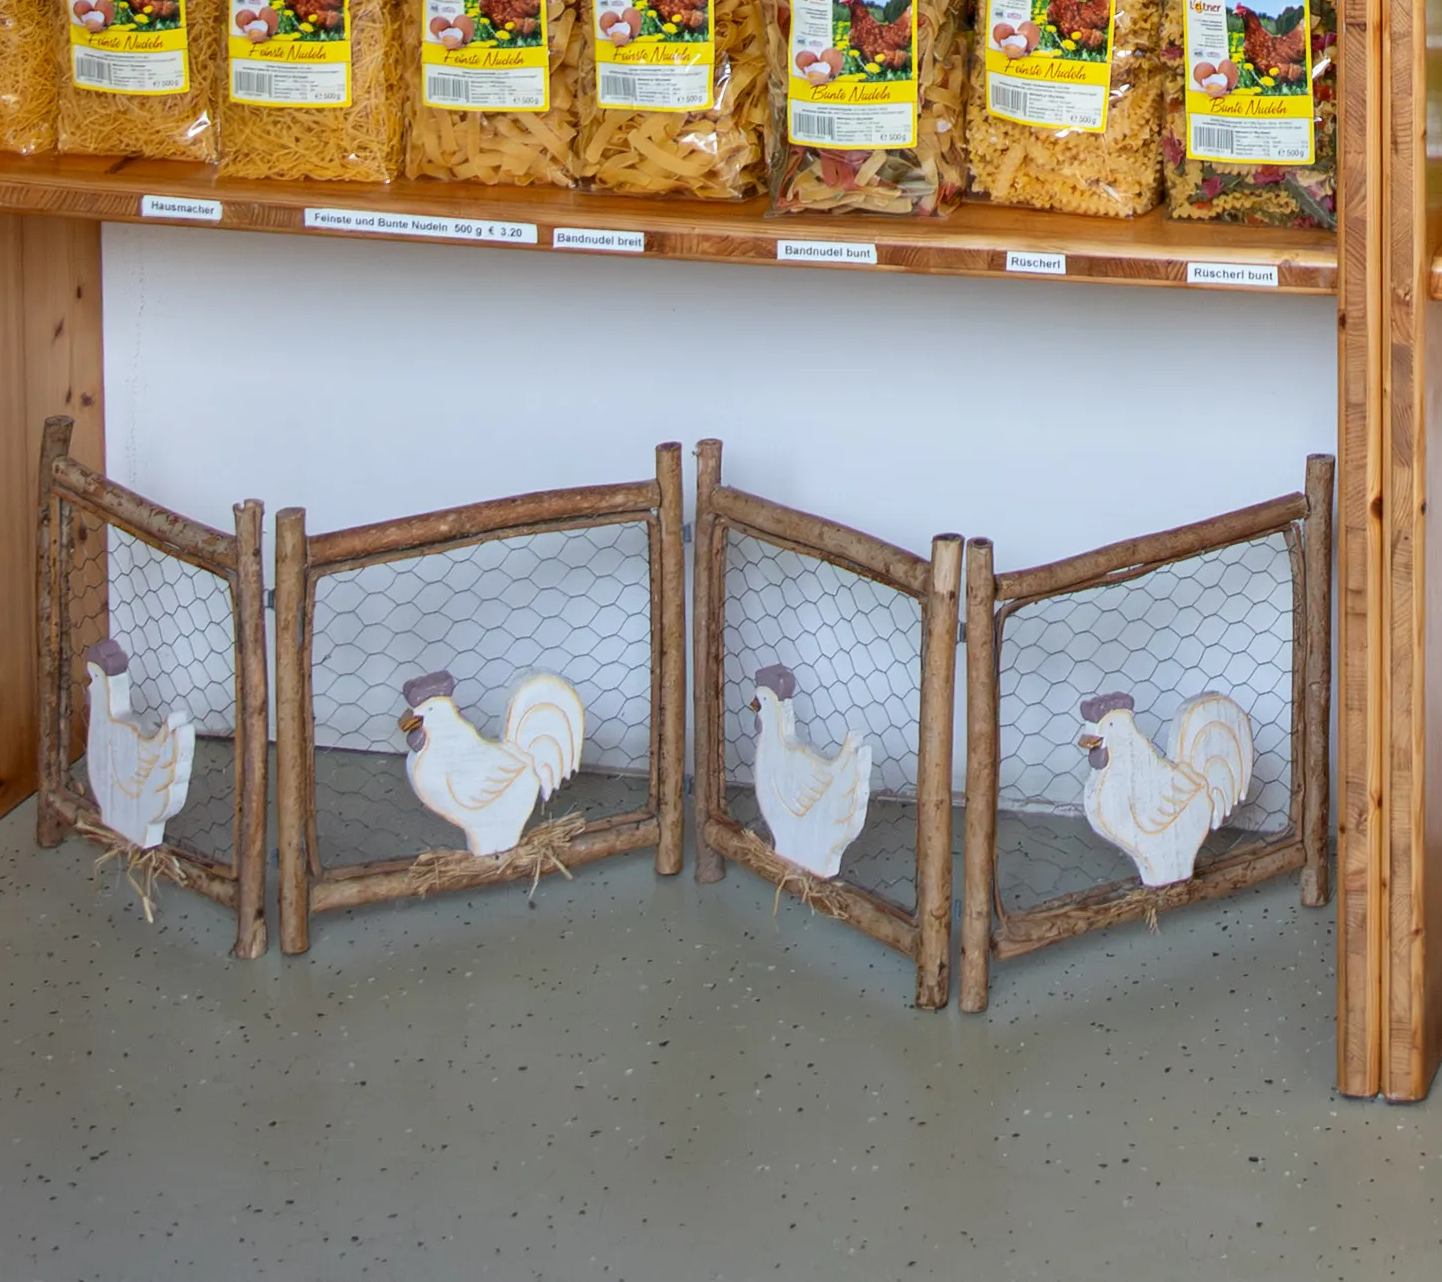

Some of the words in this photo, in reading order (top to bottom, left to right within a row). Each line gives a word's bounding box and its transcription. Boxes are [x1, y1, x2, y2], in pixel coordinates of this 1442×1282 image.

[1209, 96, 1243, 114] Bunte
[1245, 98, 1288, 116] Nudeln
[150, 201, 215, 215] Hausmacher
[314, 212, 352, 225] Feinste
[355, 217, 375, 227] und
[377, 217, 409, 229] Bunte
[411, 220, 448, 232] Nudeln
[454, 223, 474, 235] 500
[500, 226, 524, 238] 3.20
[556, 233, 615, 245] Bandnudel
[617, 236, 642, 247] breit
[784, 245, 843, 257] Bandnudel
[846, 248, 871, 258] bunt
[1247, 270, 1273, 281] bunt
